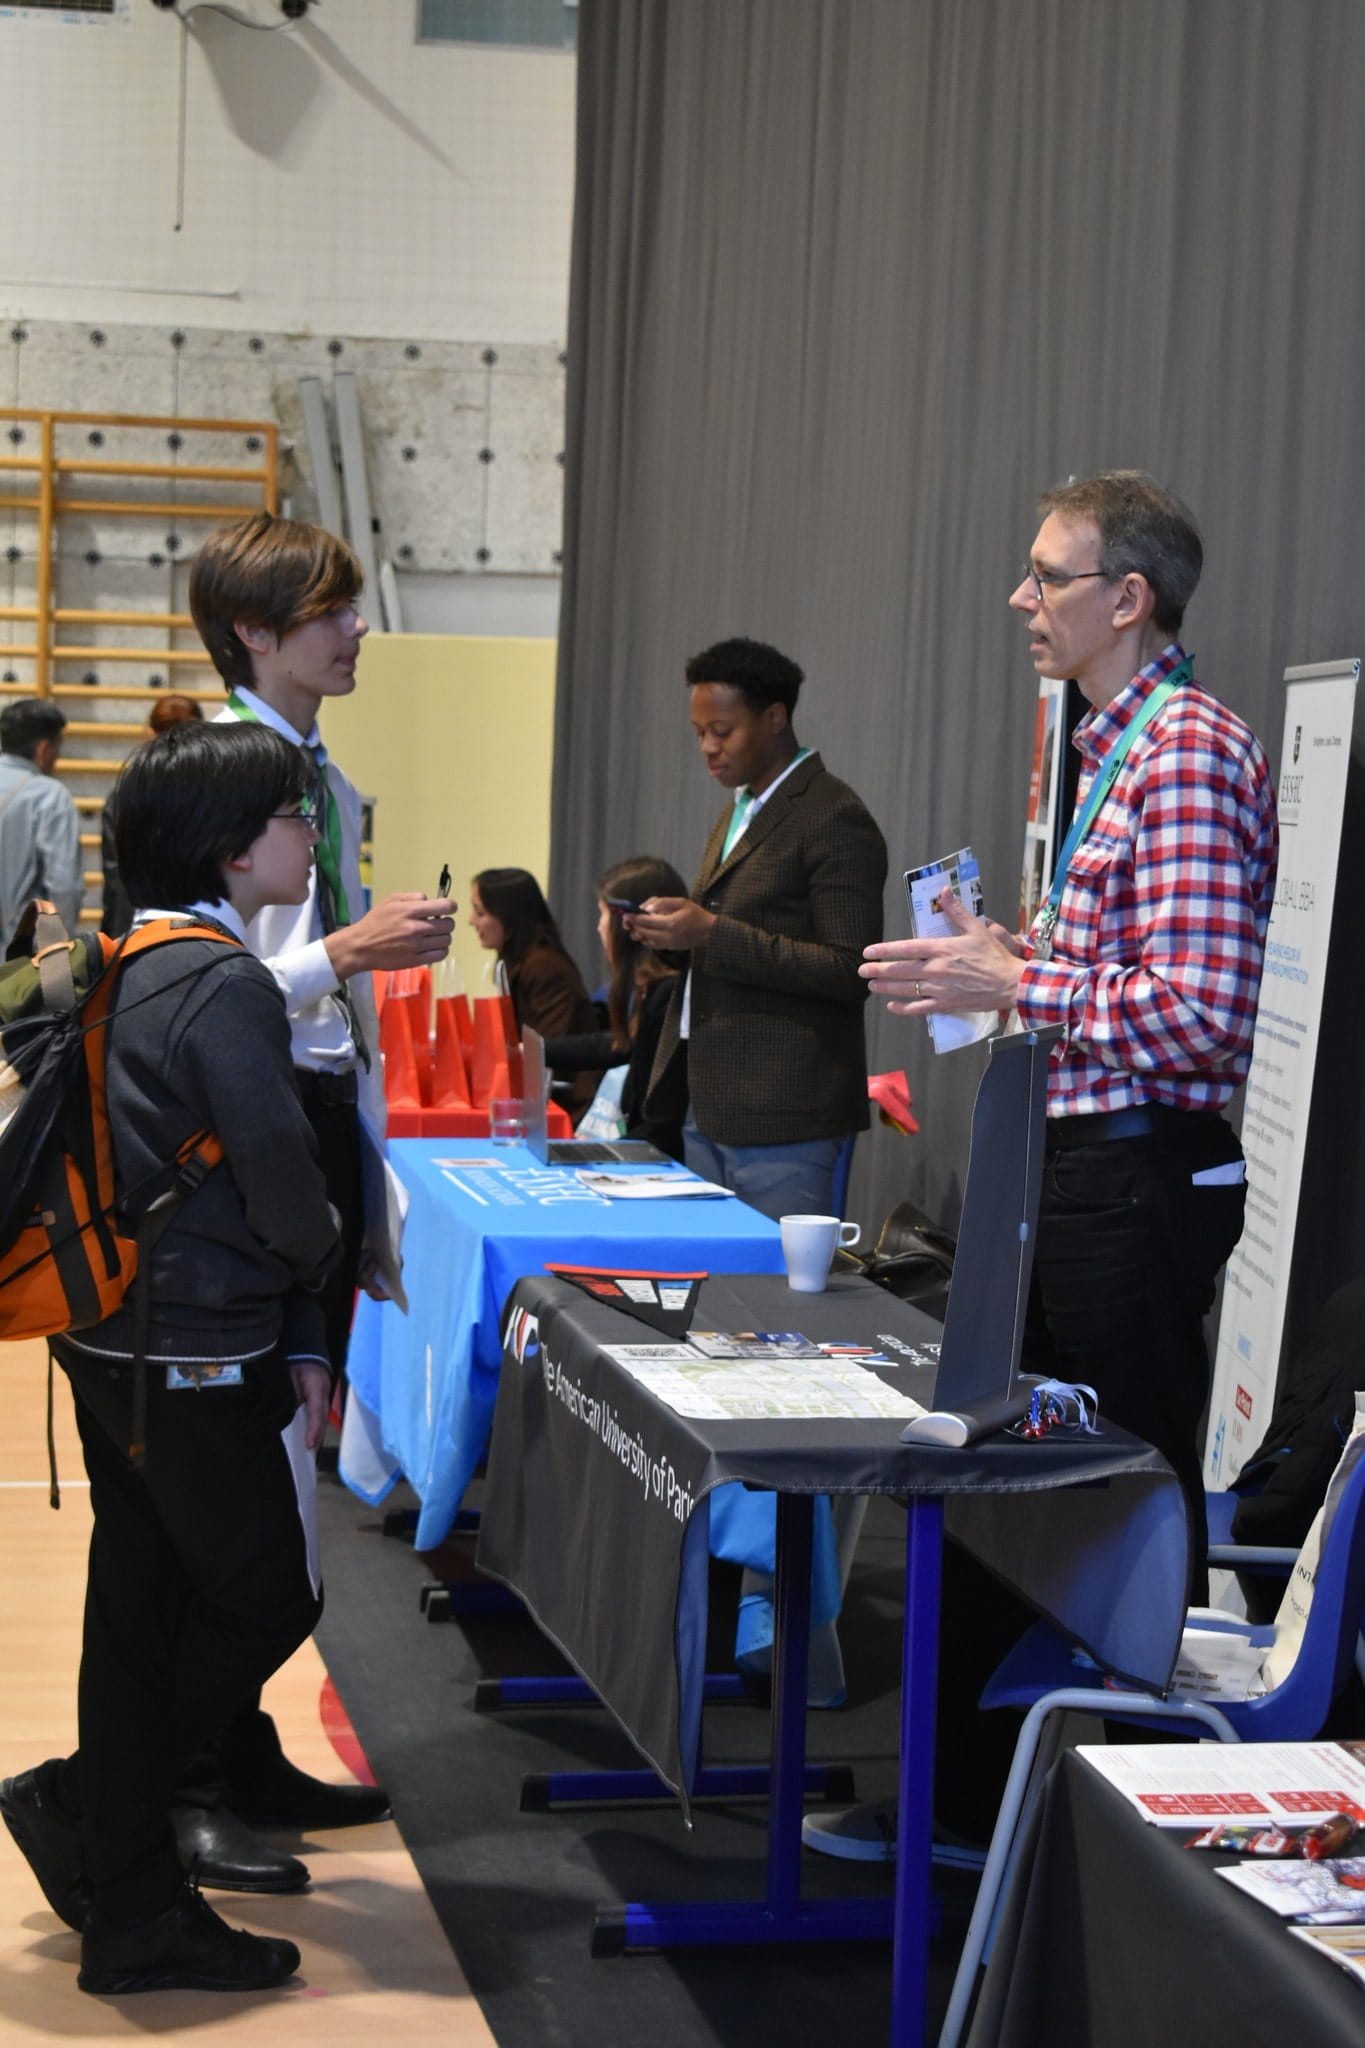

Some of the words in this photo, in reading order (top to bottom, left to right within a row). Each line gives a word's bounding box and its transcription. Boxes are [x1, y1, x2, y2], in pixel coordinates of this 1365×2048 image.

[1280, 774, 1304, 804] ESSEC
[555, 1361, 600, 1435] American
[601, 1399, 651, 1501] University
[652, 1455, 667, 1501] of
